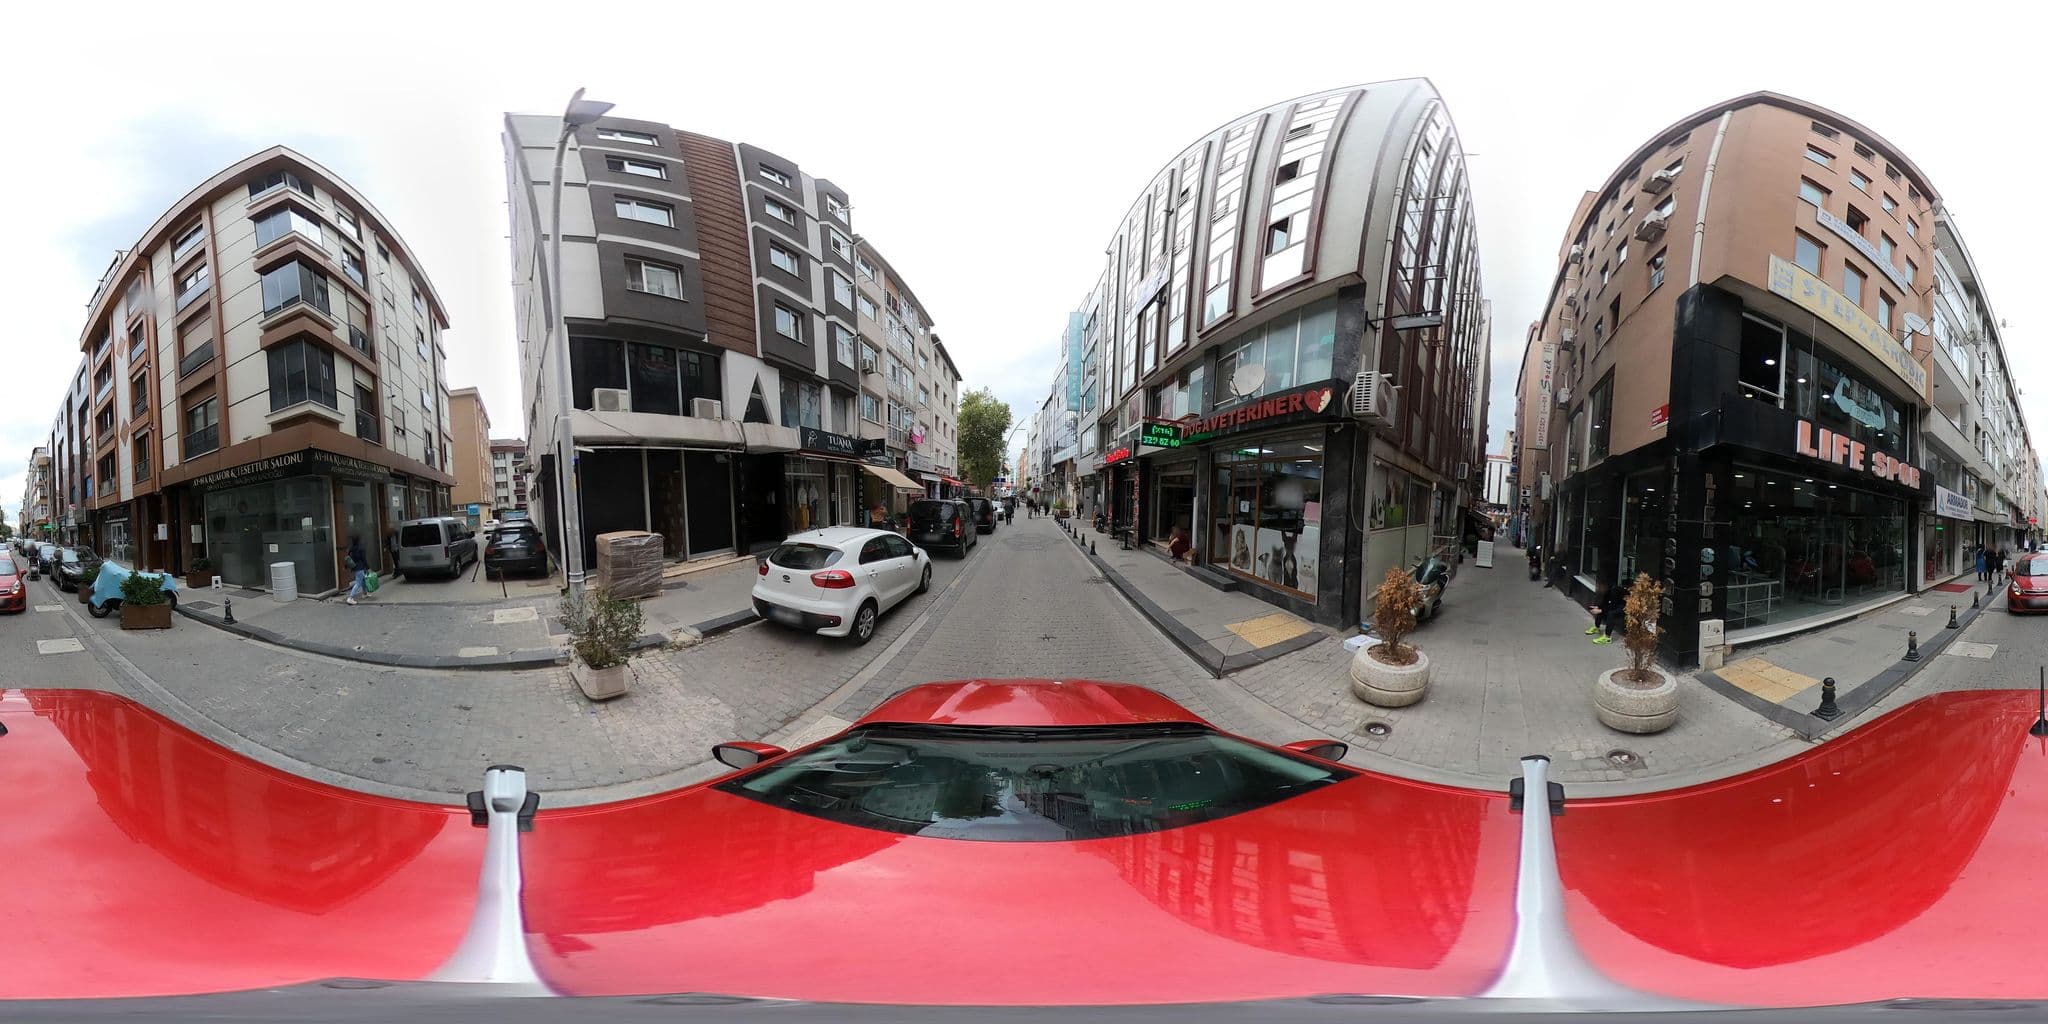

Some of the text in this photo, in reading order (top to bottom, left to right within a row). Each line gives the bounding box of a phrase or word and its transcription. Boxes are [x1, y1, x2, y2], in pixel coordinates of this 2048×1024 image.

[270, 452, 304, 469] SALONU
[1796, 419, 1920, 490] LIFE SPOR
[1700, 547, 1715, 613] SPOR
